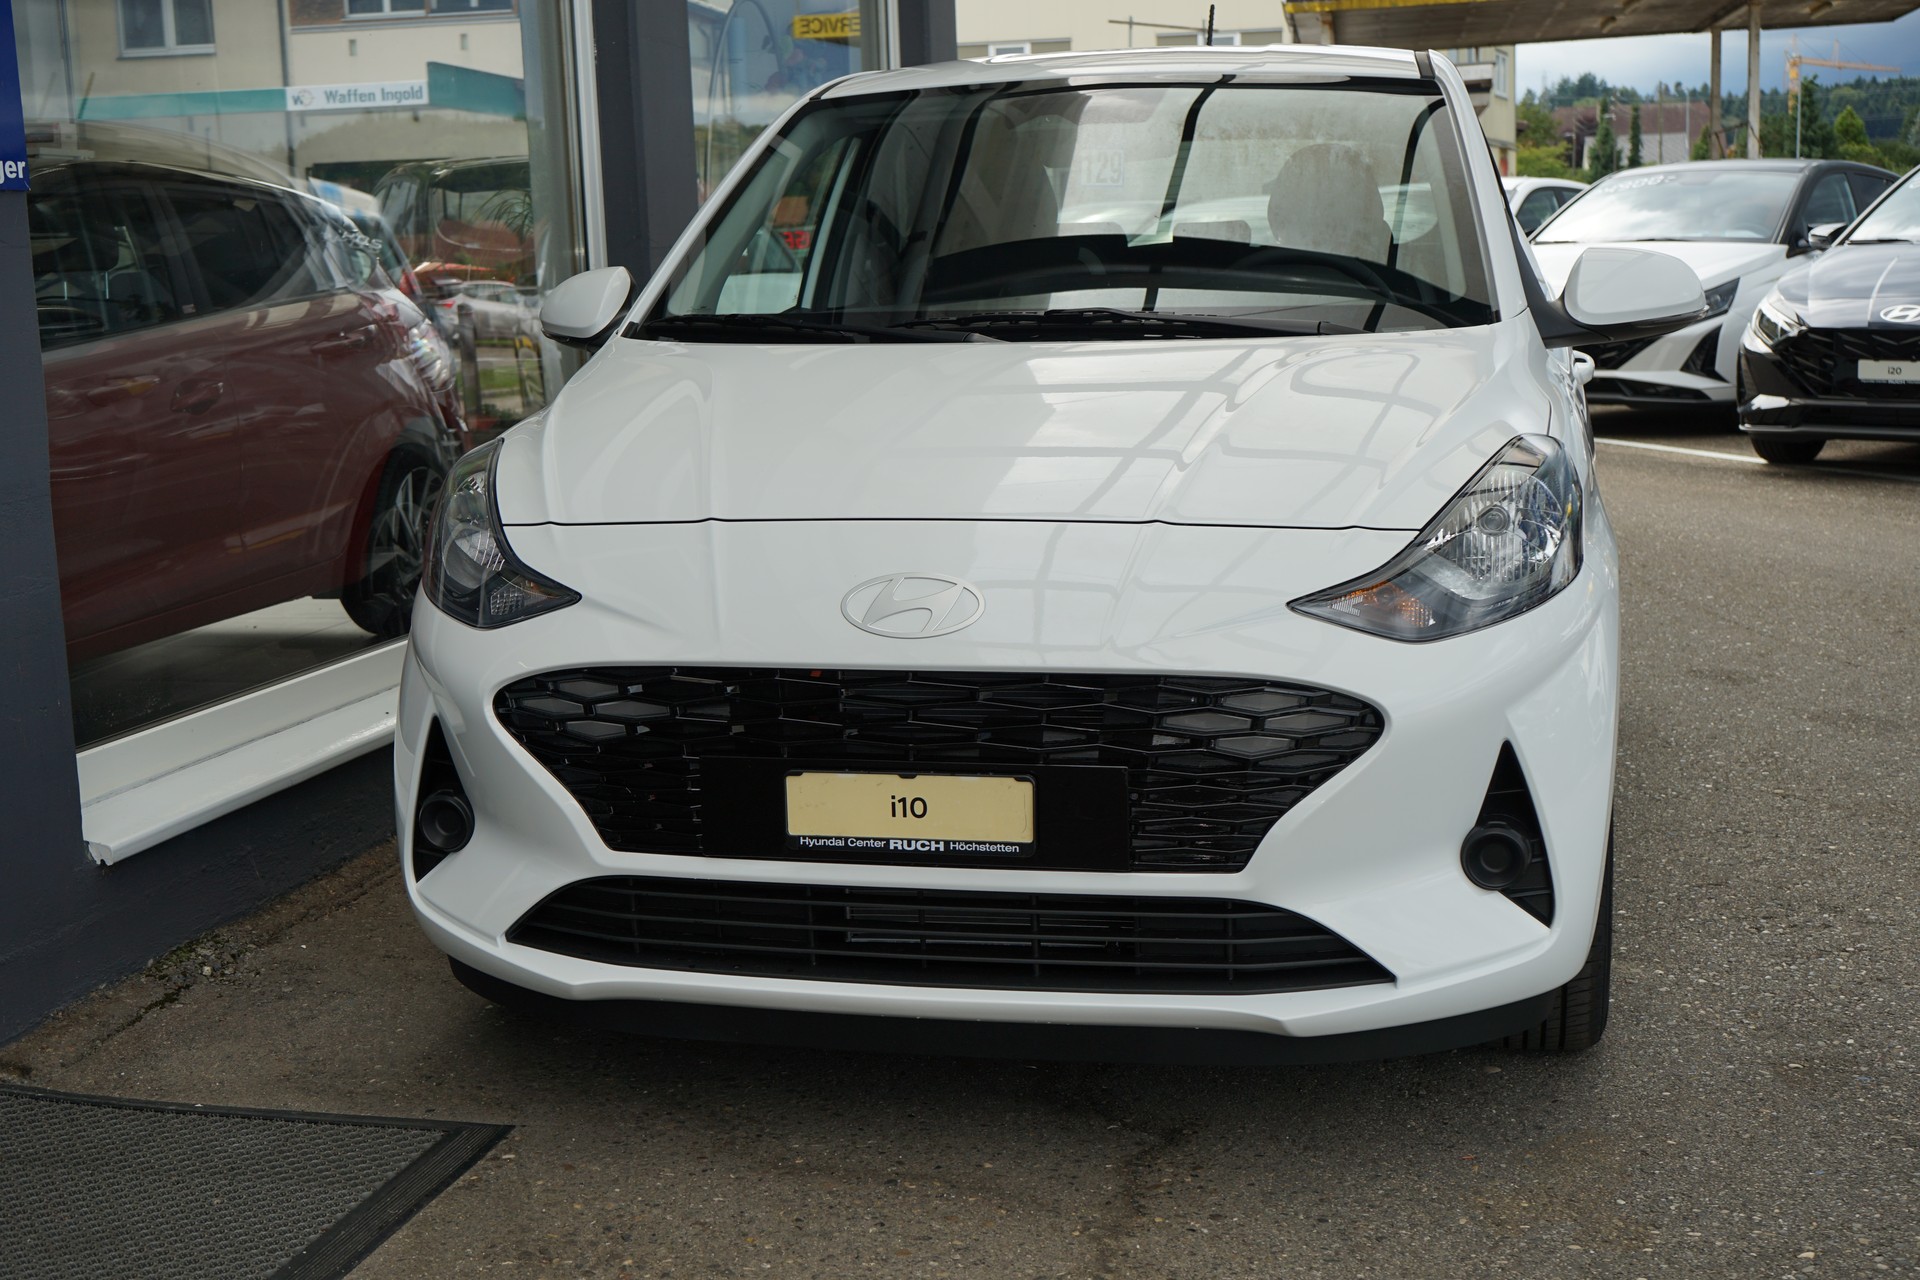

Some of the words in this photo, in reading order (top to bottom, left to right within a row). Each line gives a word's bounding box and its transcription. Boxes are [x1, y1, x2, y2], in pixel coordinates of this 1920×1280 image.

[324, 88, 377, 104] Waffen
[381, 86, 424, 103] Ingold
[1887, 366, 1903, 376] i20
[890, 795, 928, 819] i10
[800, 836, 845, 848] Hyundai
[847, 838, 887, 849] Center
[889, 839, 945, 852] RUCH
[950, 841, 1020, 853] Höchstetten
